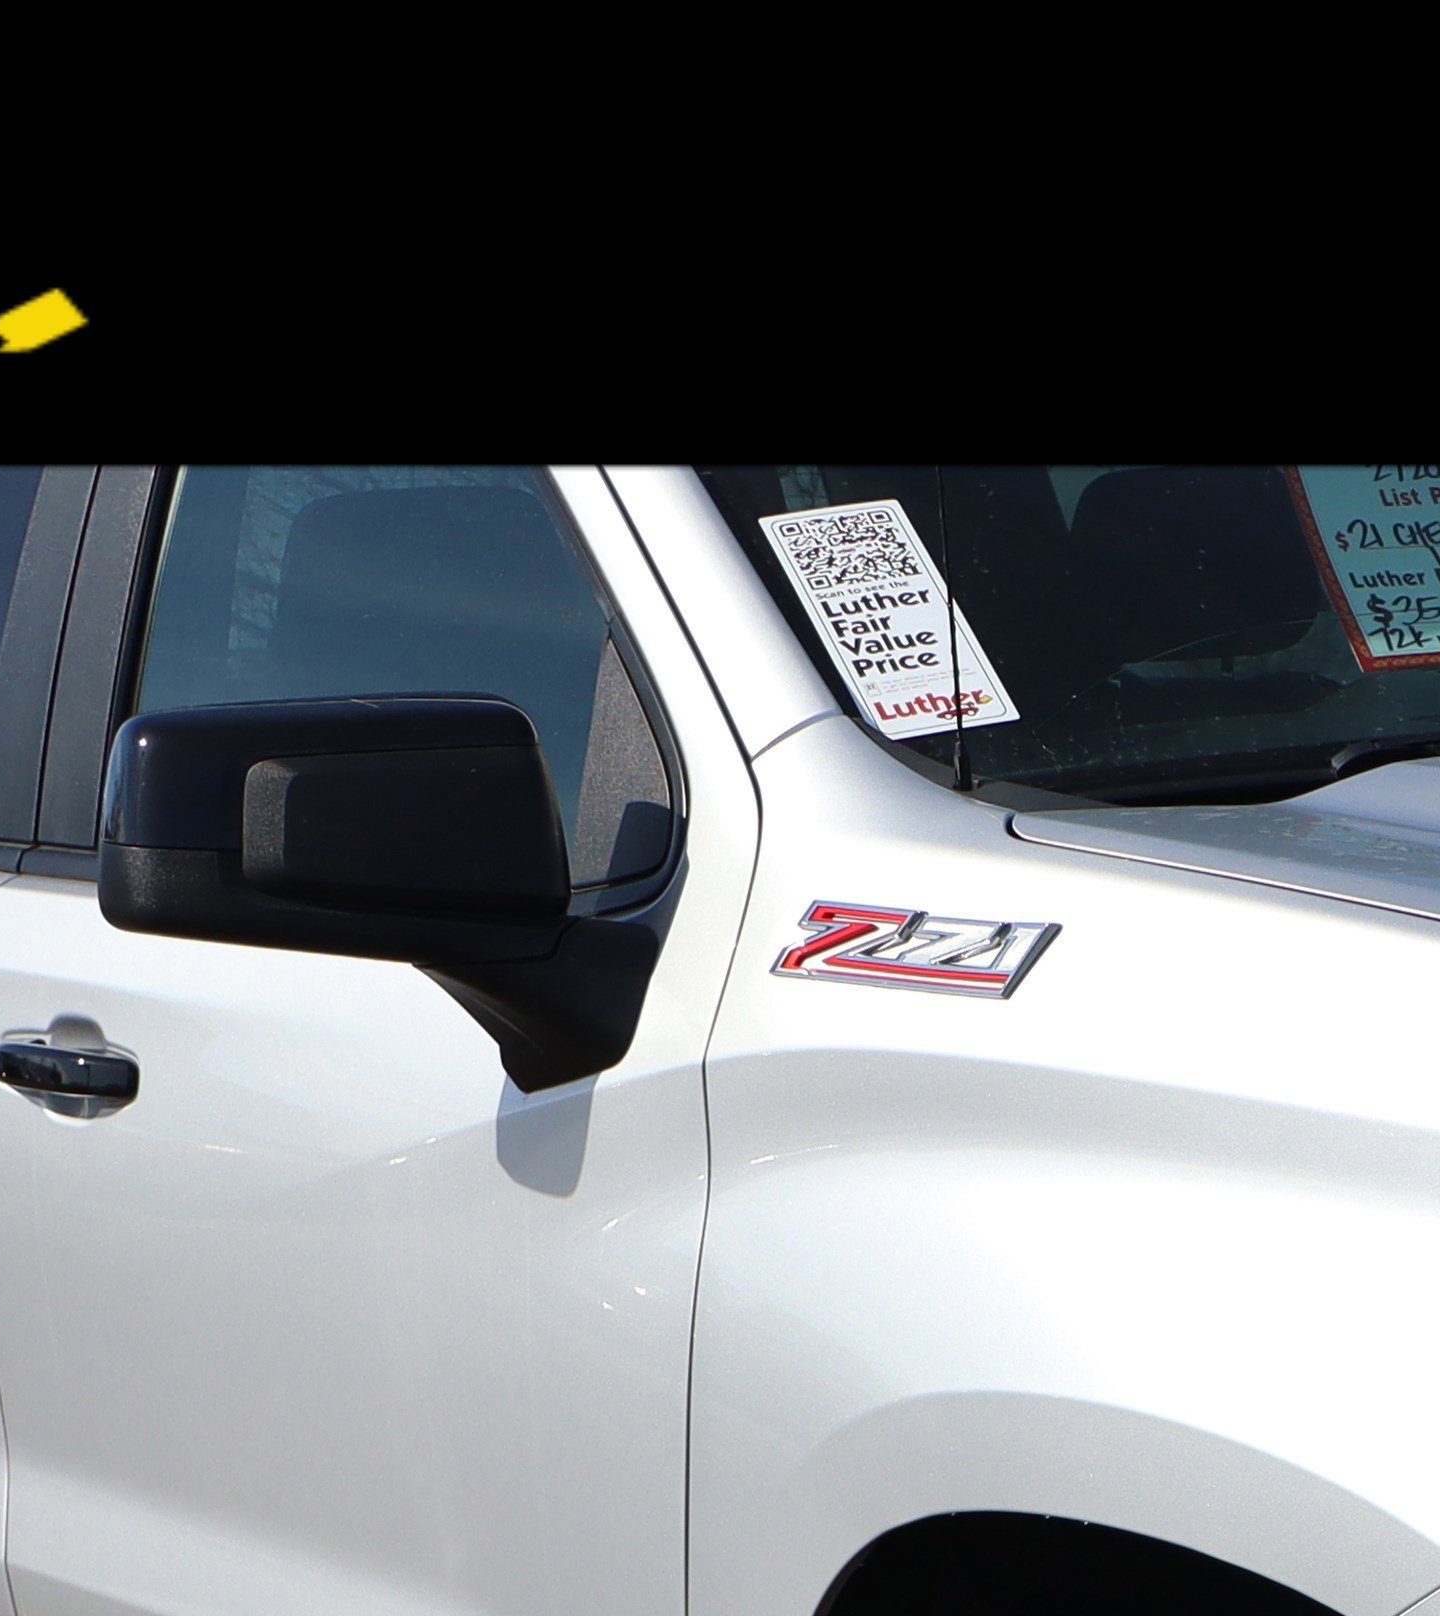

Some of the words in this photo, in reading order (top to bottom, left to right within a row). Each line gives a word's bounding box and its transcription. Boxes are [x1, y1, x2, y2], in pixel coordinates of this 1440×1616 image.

[1378, 488, 1422, 507] List
[815, 590, 845, 600] Scan
[865, 584, 887, 592] see
[889, 580, 911, 589] the
[1348, 571, 1425, 588] Luther
[820, 589, 930, 618] Luther
[831, 613, 891, 638] Fair
[839, 631, 939, 656] Value
[851, 652, 941, 678] Price
[874, 688, 984, 721] Luther
[768, 899, 1064, 1001] Z71
